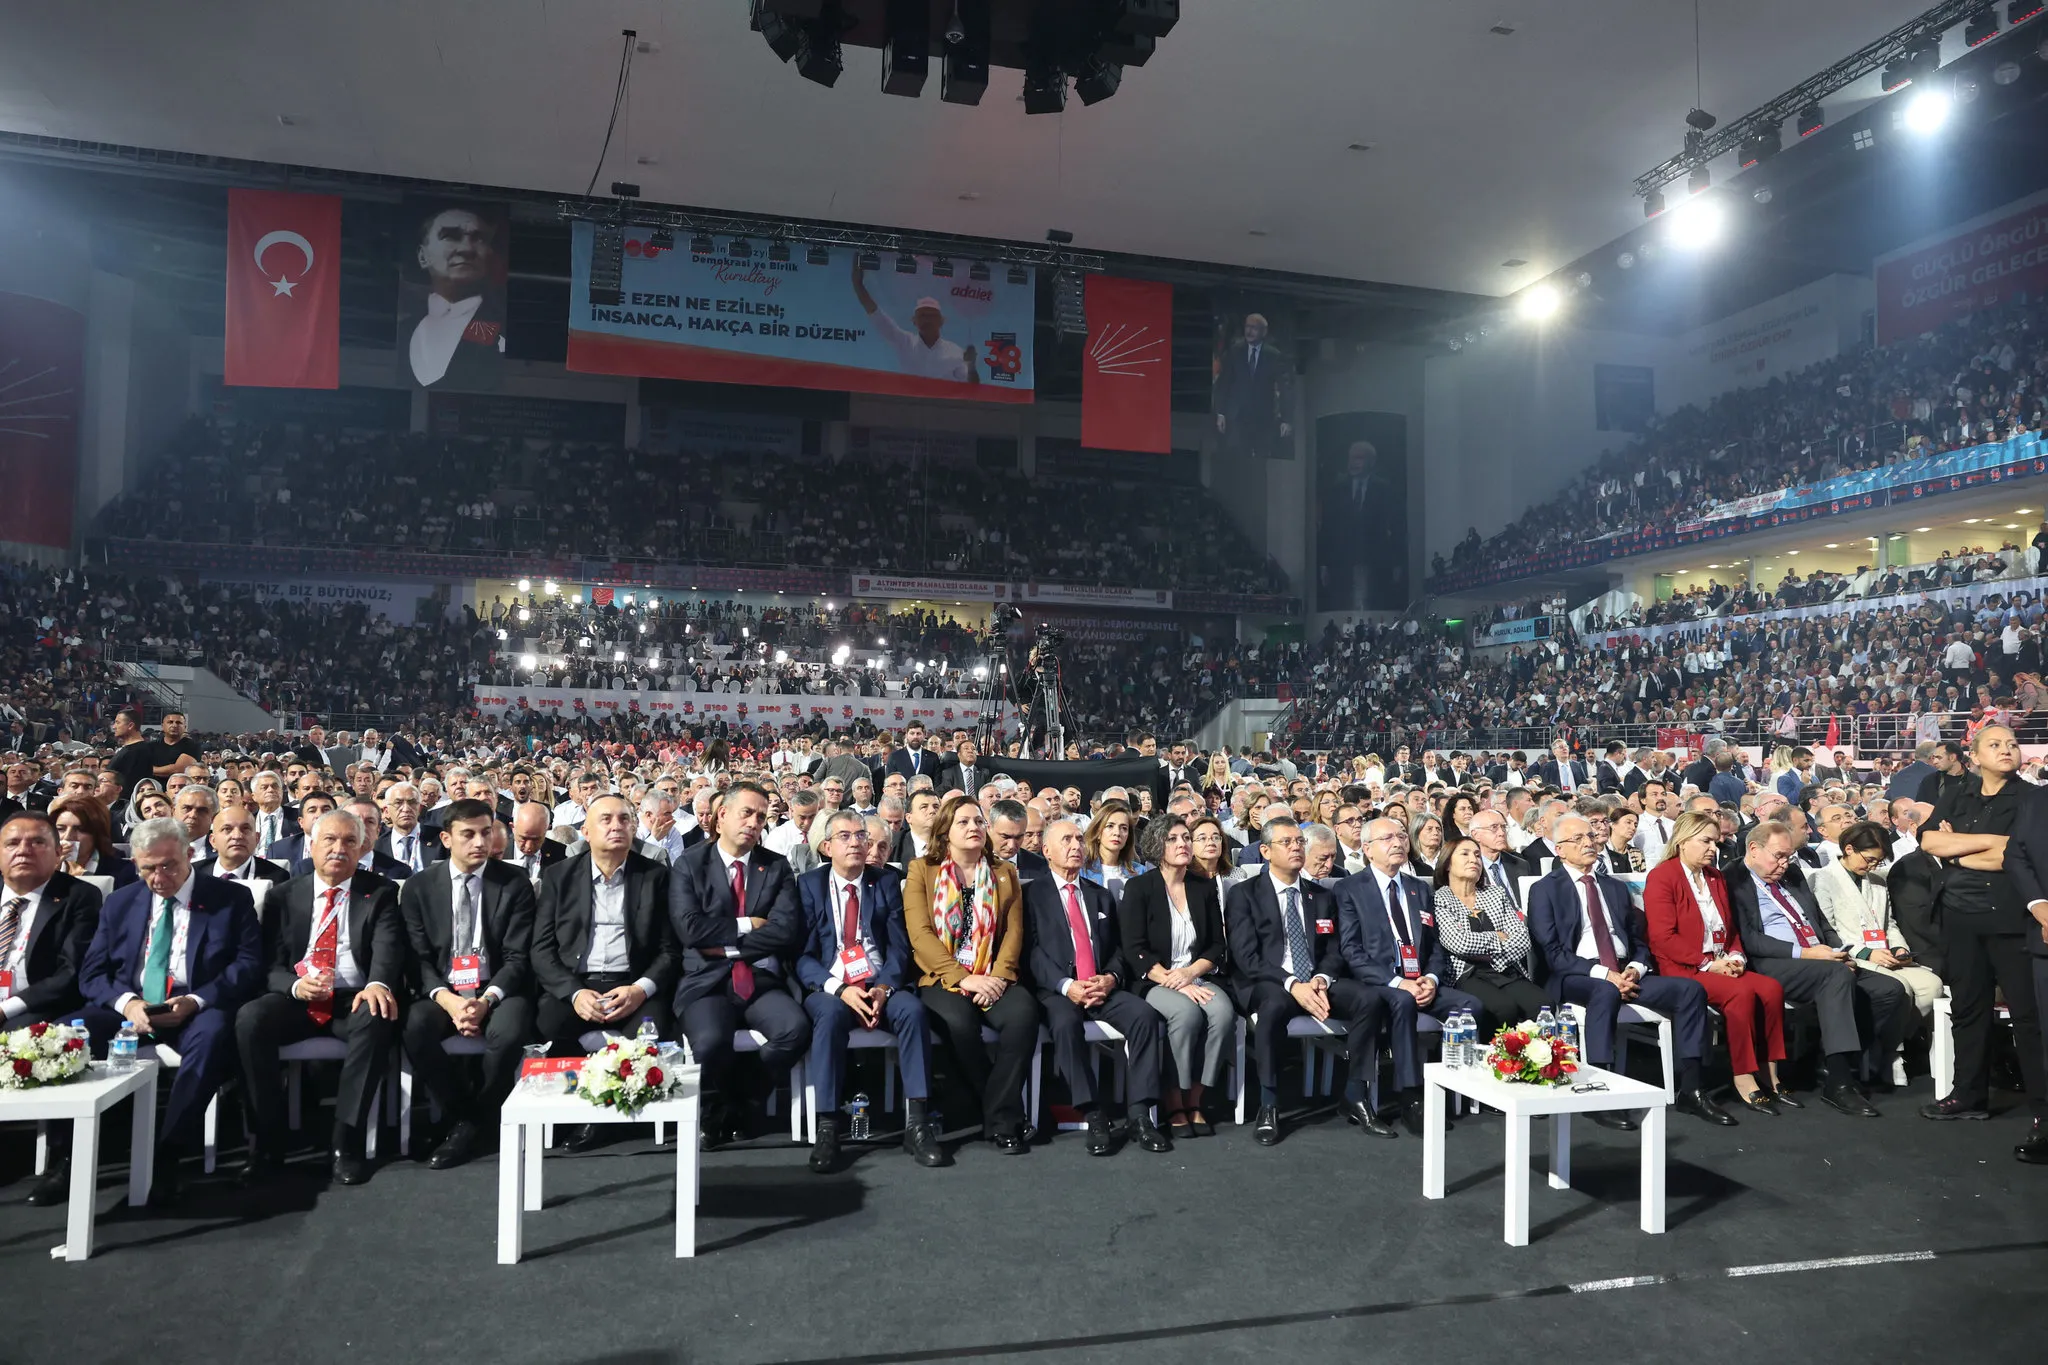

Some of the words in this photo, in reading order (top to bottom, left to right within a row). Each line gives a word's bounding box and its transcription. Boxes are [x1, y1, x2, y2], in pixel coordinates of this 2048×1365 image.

[692, 254, 751, 268] Demokrasi
[769, 261, 798, 272] Birlik
[1911, 242, 1974, 281] GÜÇLÜ
[710, 263, 783, 297] Kurultayı
[951, 286, 994, 302] adalet
[1902, 273, 1966, 308] ÖZGÜR
[631, 292, 680, 308] EZEN
[686, 296, 711, 311] NE
[715, 297, 785, 320] EZİLEN;
[591, 305, 683, 331] İNSANCA,
[688, 316, 753, 335] HAKÇA
[758, 320, 790, 337] BİR
[795, 324, 866, 342] DÜZEN"
[984, 340, 1021, 373] 38
[289, 583, 313, 596] BİZ
[317, 584, 393, 602] BÜTÜNÜZ;
[959, 583, 988, 591] OLARAK
[849, 967, 868, 977] DELEGE
